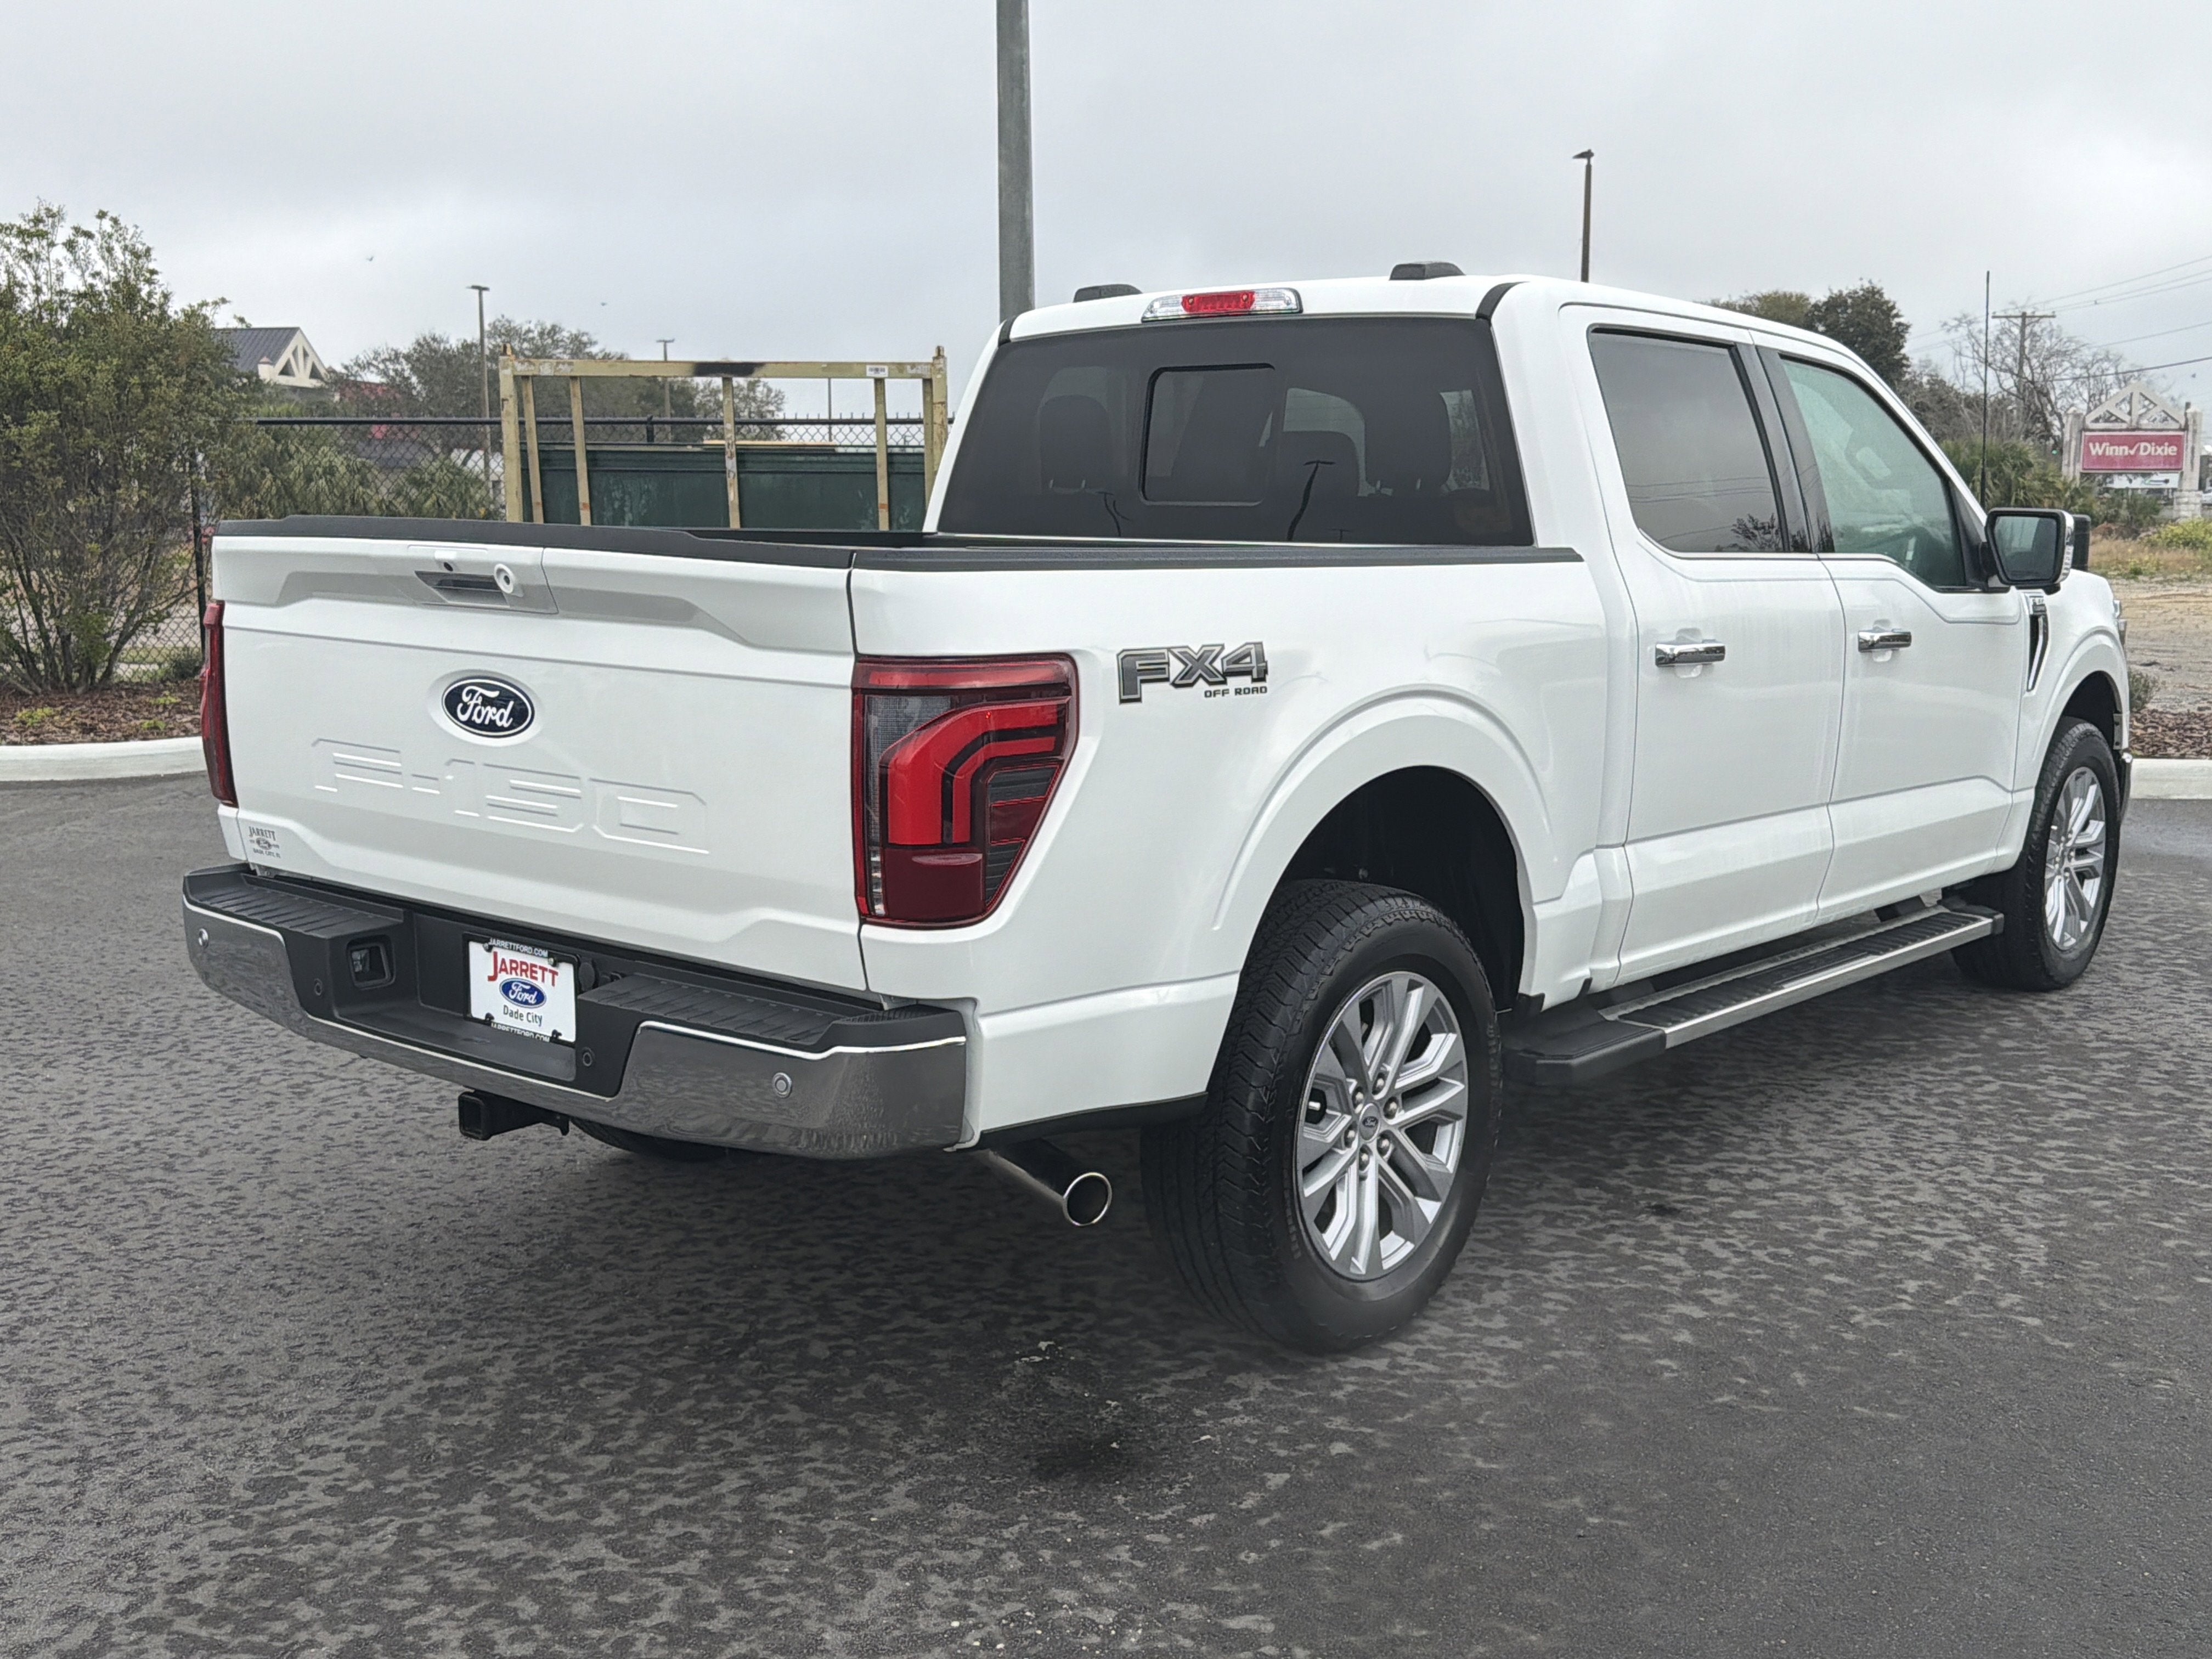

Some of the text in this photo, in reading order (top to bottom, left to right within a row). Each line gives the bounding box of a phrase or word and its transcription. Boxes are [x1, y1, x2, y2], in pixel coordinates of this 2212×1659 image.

[2089, 442, 2177, 456] Winn Dixie
[1116, 641, 1268, 705] FX4
[1204, 686, 1268, 698] OFF ROAD
[456, 685, 515, 727] Ford
[488, 938, 548, 957] JARRETTFORD.COM
[488, 951, 558, 987] JARRETT
[509, 981, 538, 1003] Ford
[503, 1005, 543, 1027] Dade City
